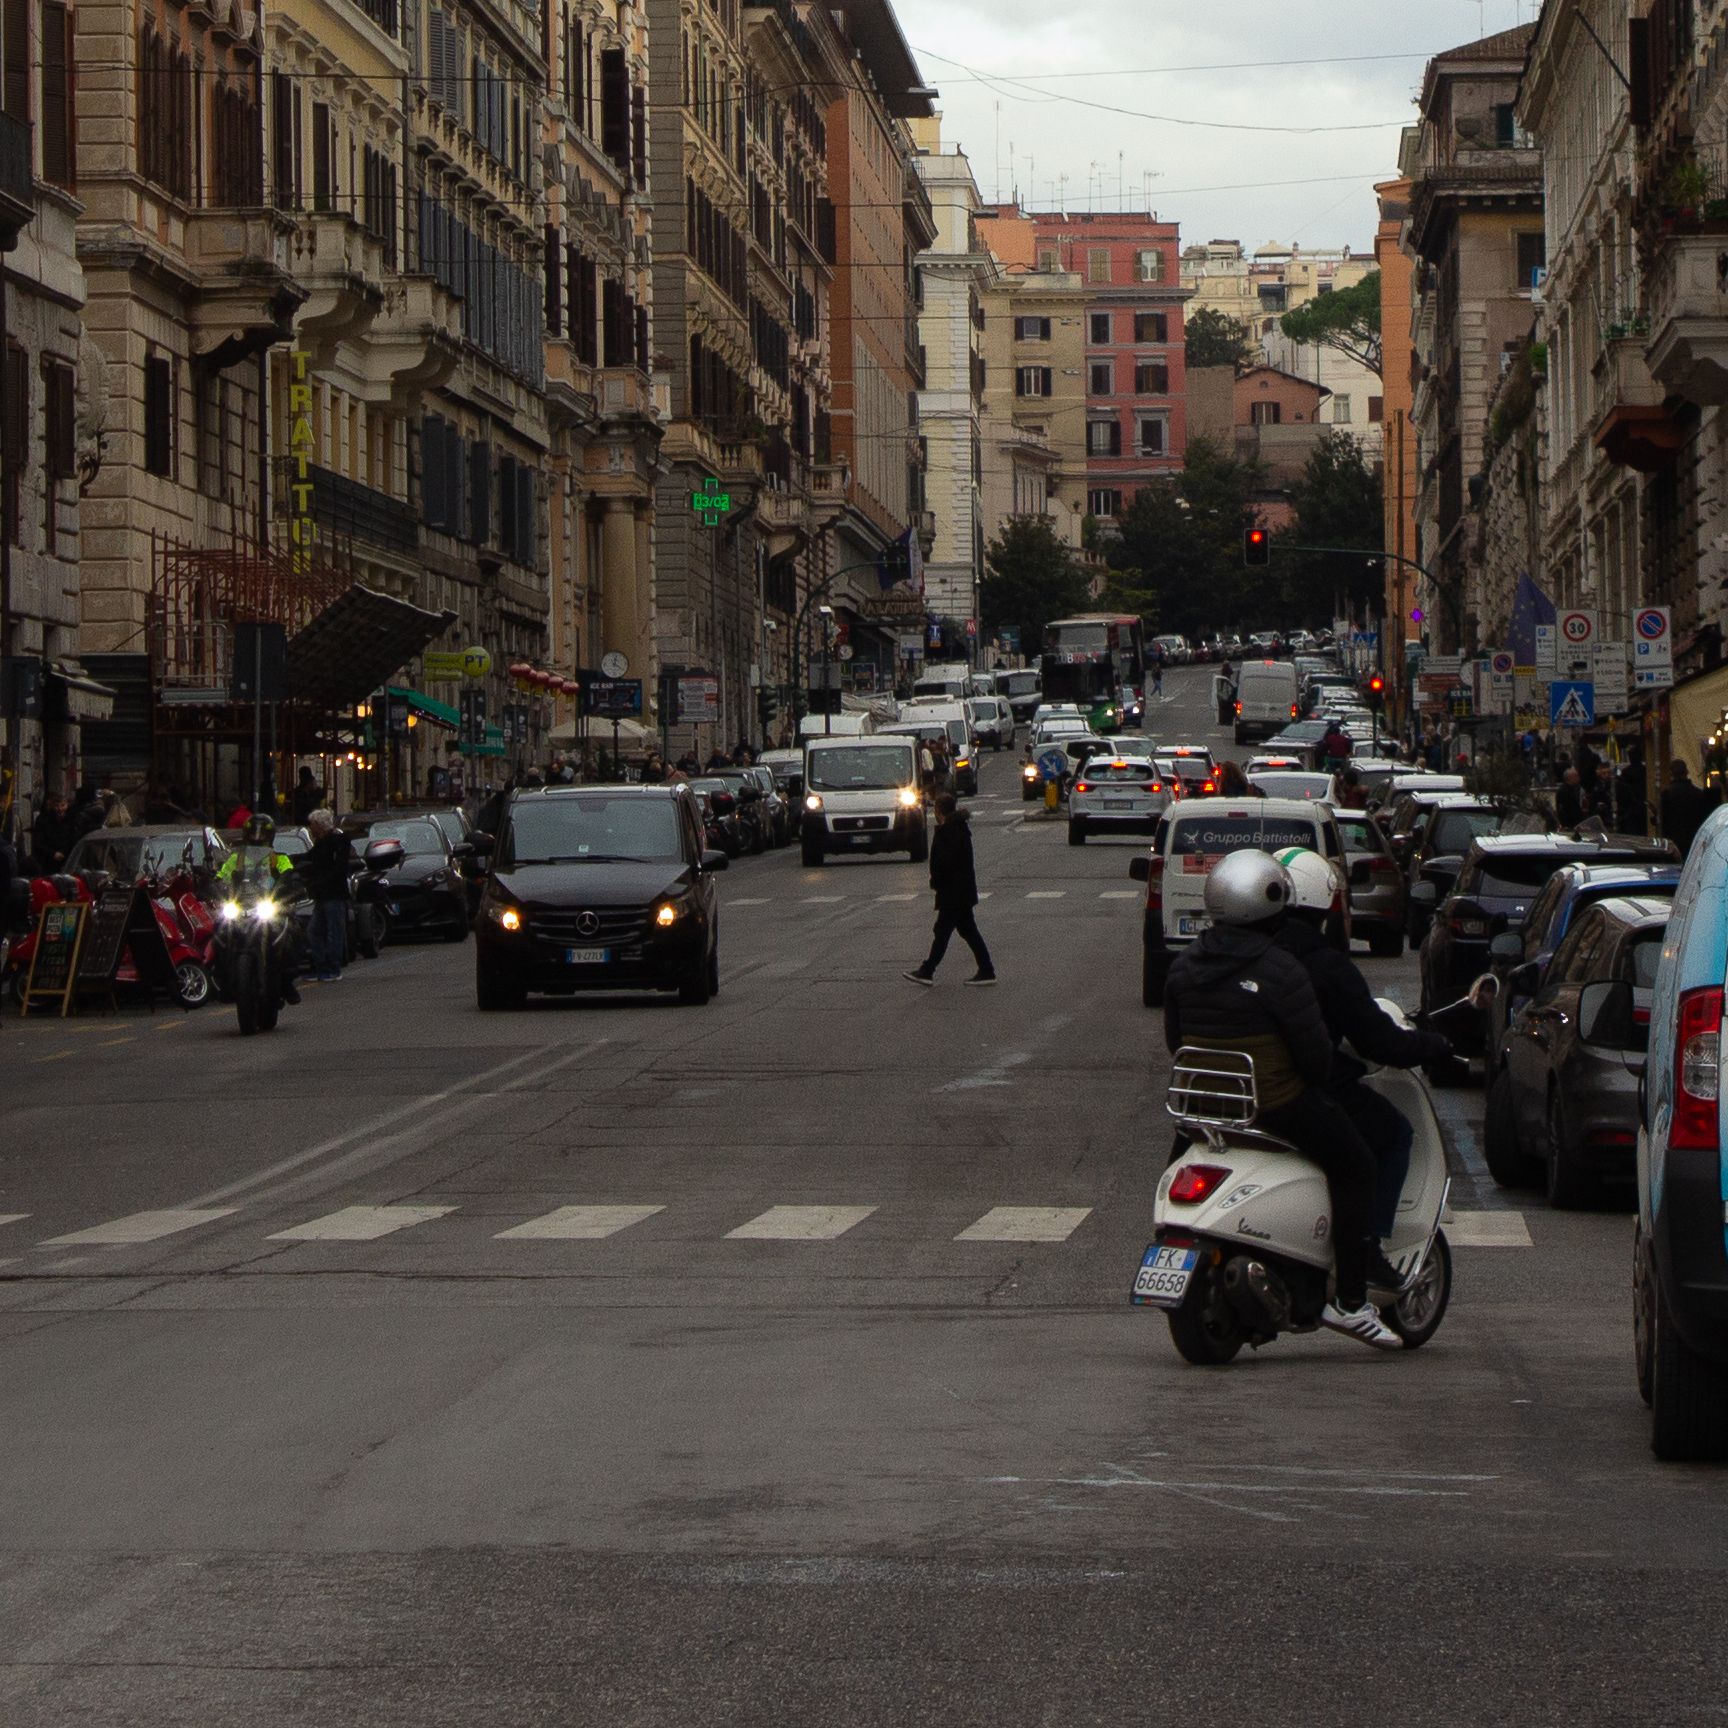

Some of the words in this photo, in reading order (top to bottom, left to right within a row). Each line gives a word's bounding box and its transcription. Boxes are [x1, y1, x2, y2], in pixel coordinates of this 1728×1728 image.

[1570, 623, 1584, 634] 30
[1203, 832, 1251, 846] Gruppo
[1252, 831, 1312, 845] Battistolli
[1155, 1248, 1178, 1267] FK
[1137, 1271, 1186, 1293] 66658
